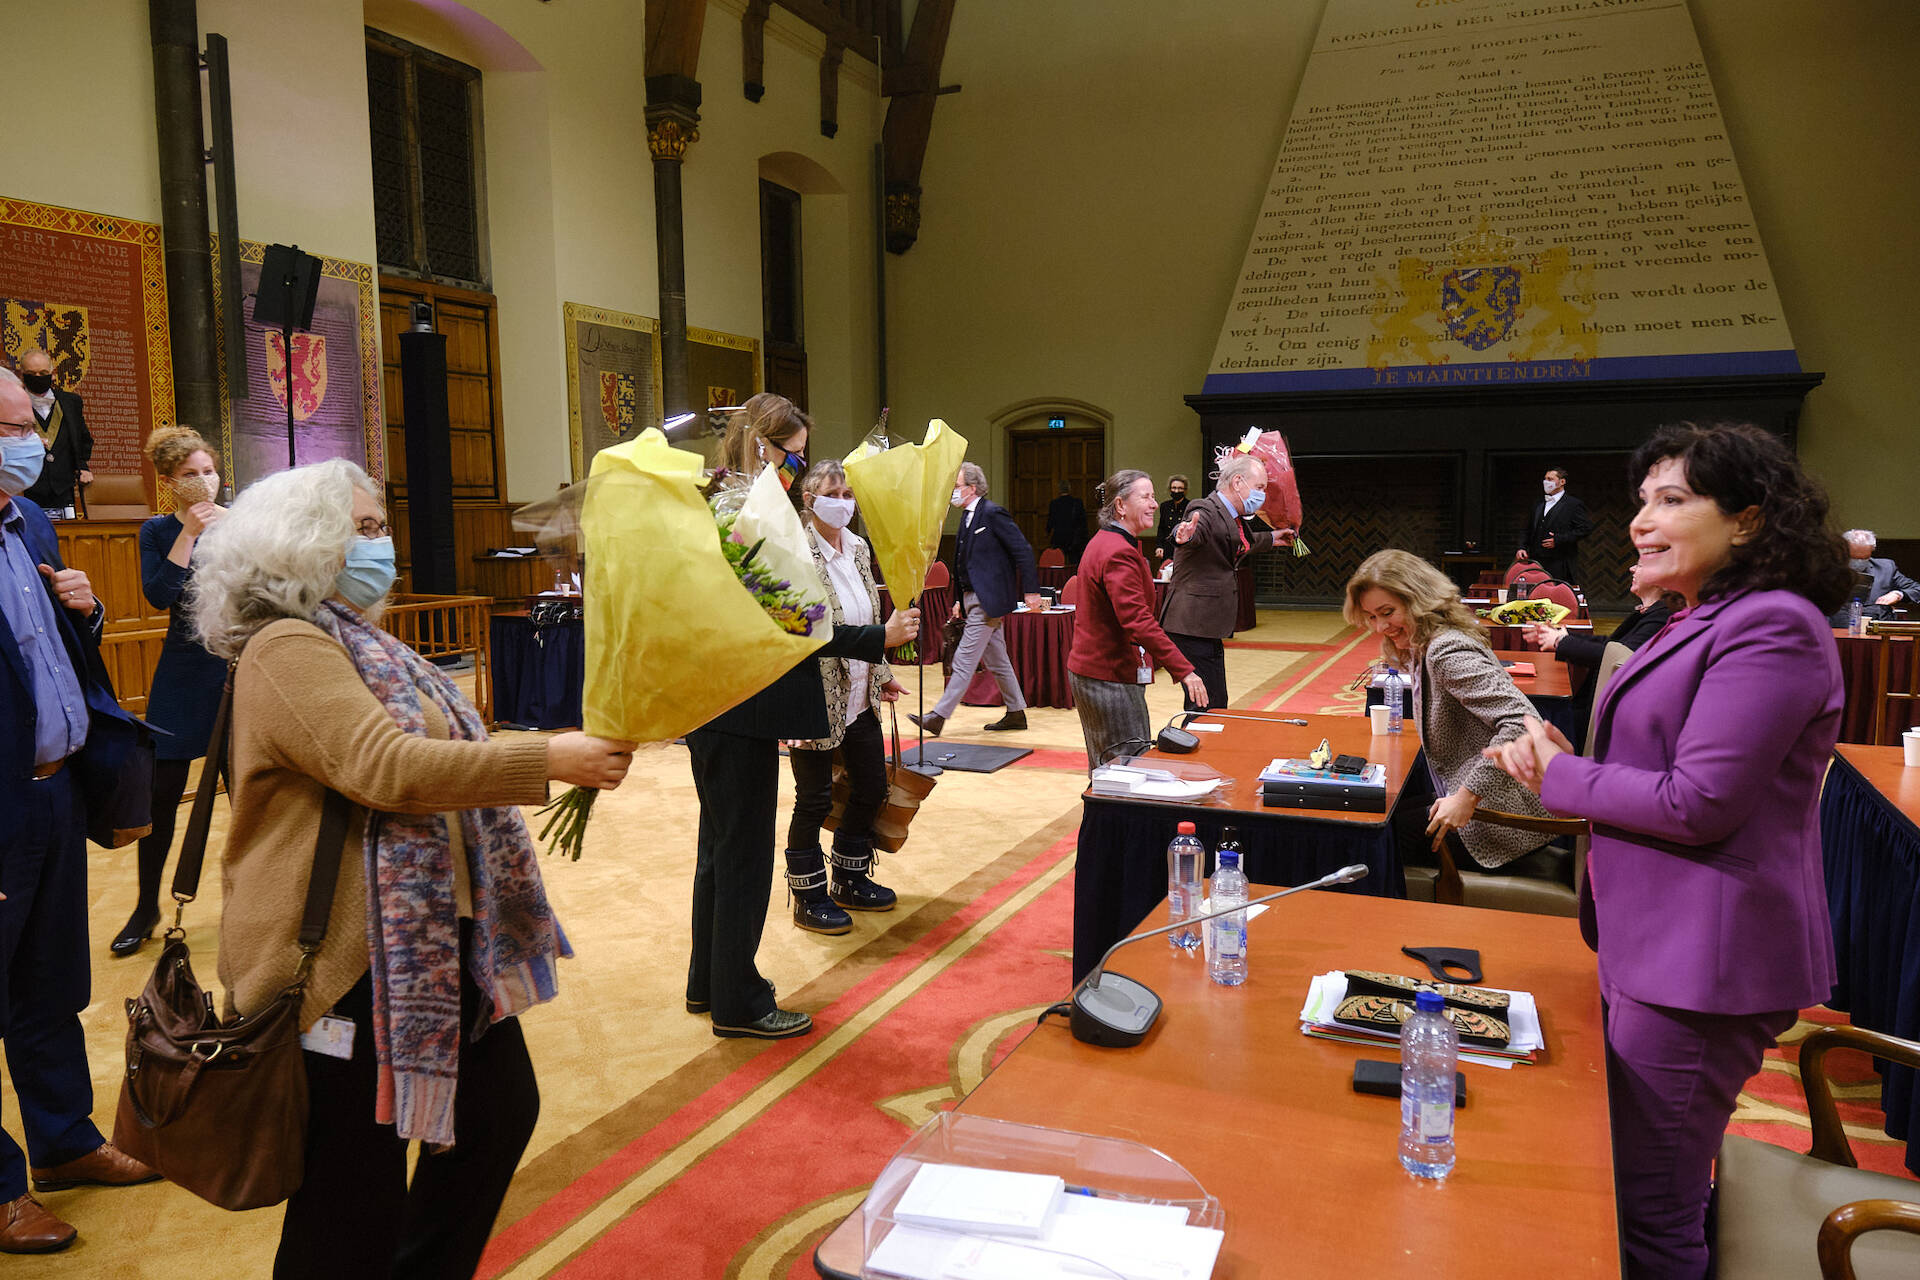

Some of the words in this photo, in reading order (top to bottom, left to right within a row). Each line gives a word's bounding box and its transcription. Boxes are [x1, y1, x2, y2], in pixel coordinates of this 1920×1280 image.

[1262, 205, 1321, 217] meenten
[1328, 199, 1382, 211] kunnen
[1389, 195, 1424, 205] door
[1432, 191, 1451, 201] de
[1456, 189, 1481, 199] wet
[1492, 184, 1548, 196] worden
[1284, 194, 1303, 204] De
[1314, 190, 1370, 204] grenzen
[1380, 186, 1406, 195] van
[1416, 182, 1442, 191] den
[1509, 174, 1537, 183] van
[1549, 170, 1568, 179] de
[1579, 163, 1663, 180] provincien
[1675, 160, 1696, 168] en
[1309, 214, 1346, 225] Allen
[1353, 211, 1376, 222] die
[1383, 207, 1413, 219] zich
[1420, 207, 1439, 218] op
[1447, 202, 1470, 213] het
[1479, 193, 1576, 213] grondgebied
[1586, 191, 1616, 201] van
[1629, 186, 1656, 197] het
[1666, 181, 1701, 196] Rijk
[1320, 223, 1359, 237] hetzij
[1365, 219, 1453, 235] ingezetenen
[1458, 214, 1472, 225] of
[1617, 199, 1678, 212] hebben
[1684, 192, 1742, 209] gelijke
[72, 239, 128, 257] VANDE
[1251, 238, 1325, 255] aanspraak
[1333, 238, 1352, 250] op
[1360, 229, 1457, 245] bescherming
[1504, 222, 1570, 237] persoon
[1577, 219, 1597, 228] en
[1267, 254, 1287, 265] De
[1300, 252, 1327, 262] wet
[1340, 247, 1382, 262] regelt
[1394, 244, 1412, 255] de
[1494, 239, 1516, 248] en
[1520, 235, 1544, 246] de
[1552, 229, 1632, 244] uitzetting
[1641, 227, 1674, 237] van
[1328, 264, 1346, 273] en
[1356, 259, 1376, 270] de
[1620, 244, 1643, 256] op
[1654, 237, 1707, 251] welke
[1724, 236, 1754, 245] ten
[1239, 281, 1297, 294] aanzien
[1305, 280, 1332, 290] van
[1339, 276, 1370, 287] hun
[1592, 258, 1626, 269] met
[1633, 251, 1712, 267] vreemde
[1237, 293, 1318, 310] gendheden
[1327, 290, 1386, 302] kunnen
[1285, 307, 1308, 319] De
[1562, 291, 1620, 305] regten
[1630, 285, 1686, 299] wordt
[1692, 283, 1736, 295] door
[1743, 280, 1768, 291] de
[1229, 325, 1257, 337] wet
[1264, 318, 1330, 336] bepaald.
[1243, 341, 1259, 353] 5.
[1277, 339, 1307, 351] Om
[1316, 336, 1360, 352] eenig
[1634, 319, 1682, 331] moet
[1690, 318, 1734, 328] men
[1741, 313, 1777, 325] Ne-
[1218, 354, 1298, 369] derlander
[1306, 351, 1342, 367] zijn.
[1372, 370, 1398, 385] JE
[1406, 363, 1591, 383] MAINTIENDRAI
